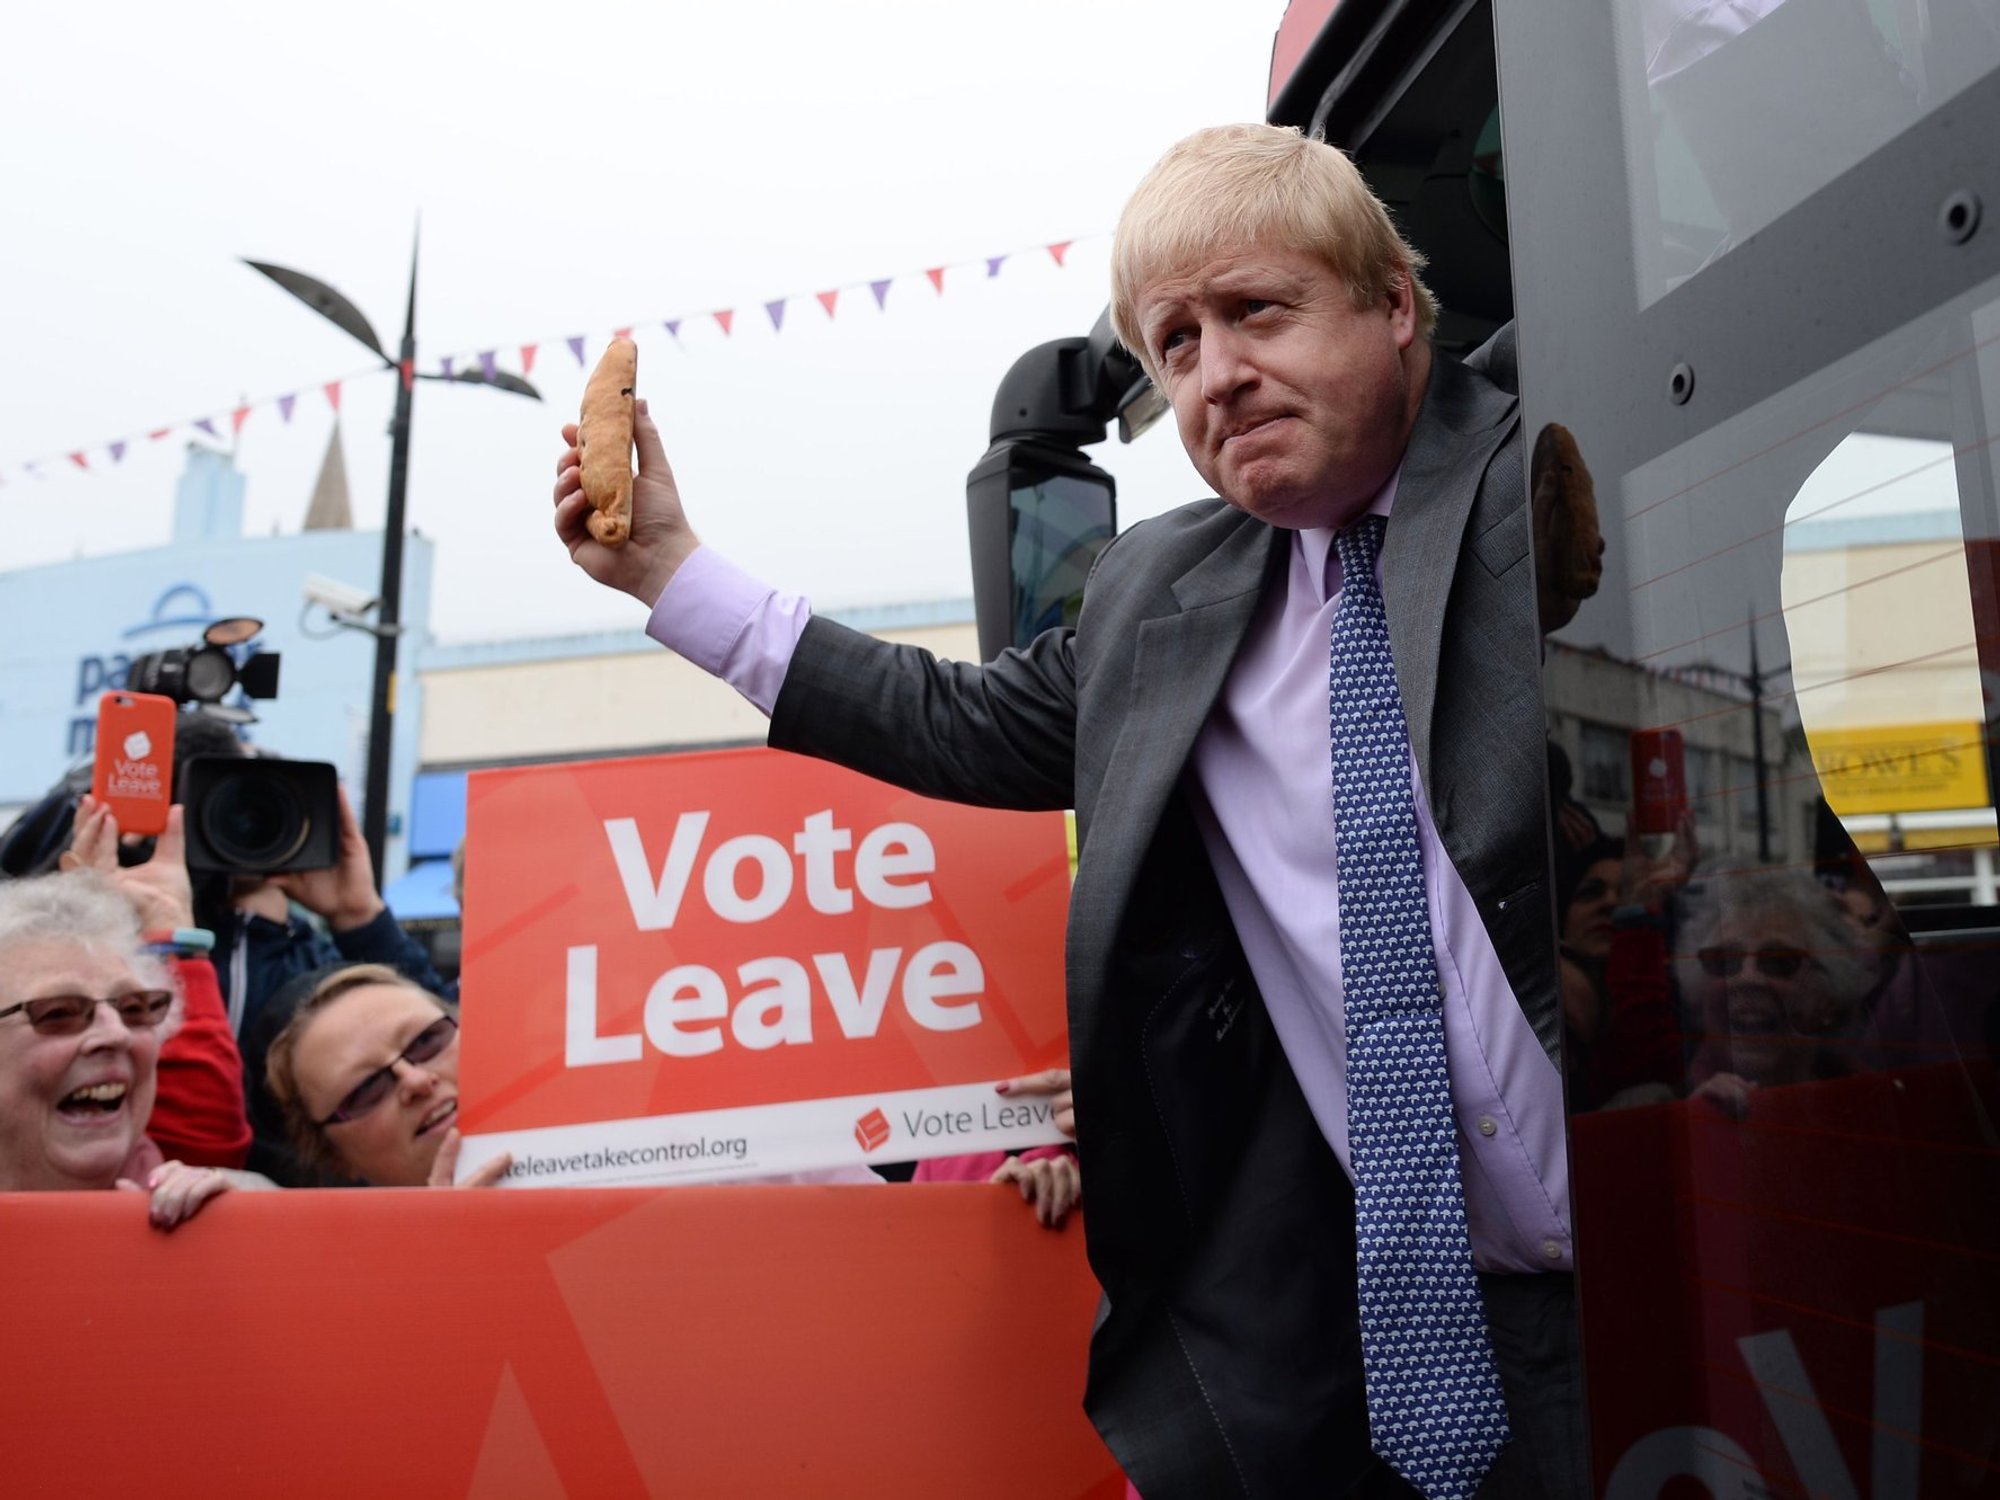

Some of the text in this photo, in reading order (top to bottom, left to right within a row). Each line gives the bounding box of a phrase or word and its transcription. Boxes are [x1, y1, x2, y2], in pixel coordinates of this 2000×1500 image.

[113, 758, 158, 778] Vote
[107, 772, 161, 794] Leave
[603, 809, 936, 932] Vote
[565, 941, 985, 1068] Leave
[903, 1109, 972, 1138] Vote
